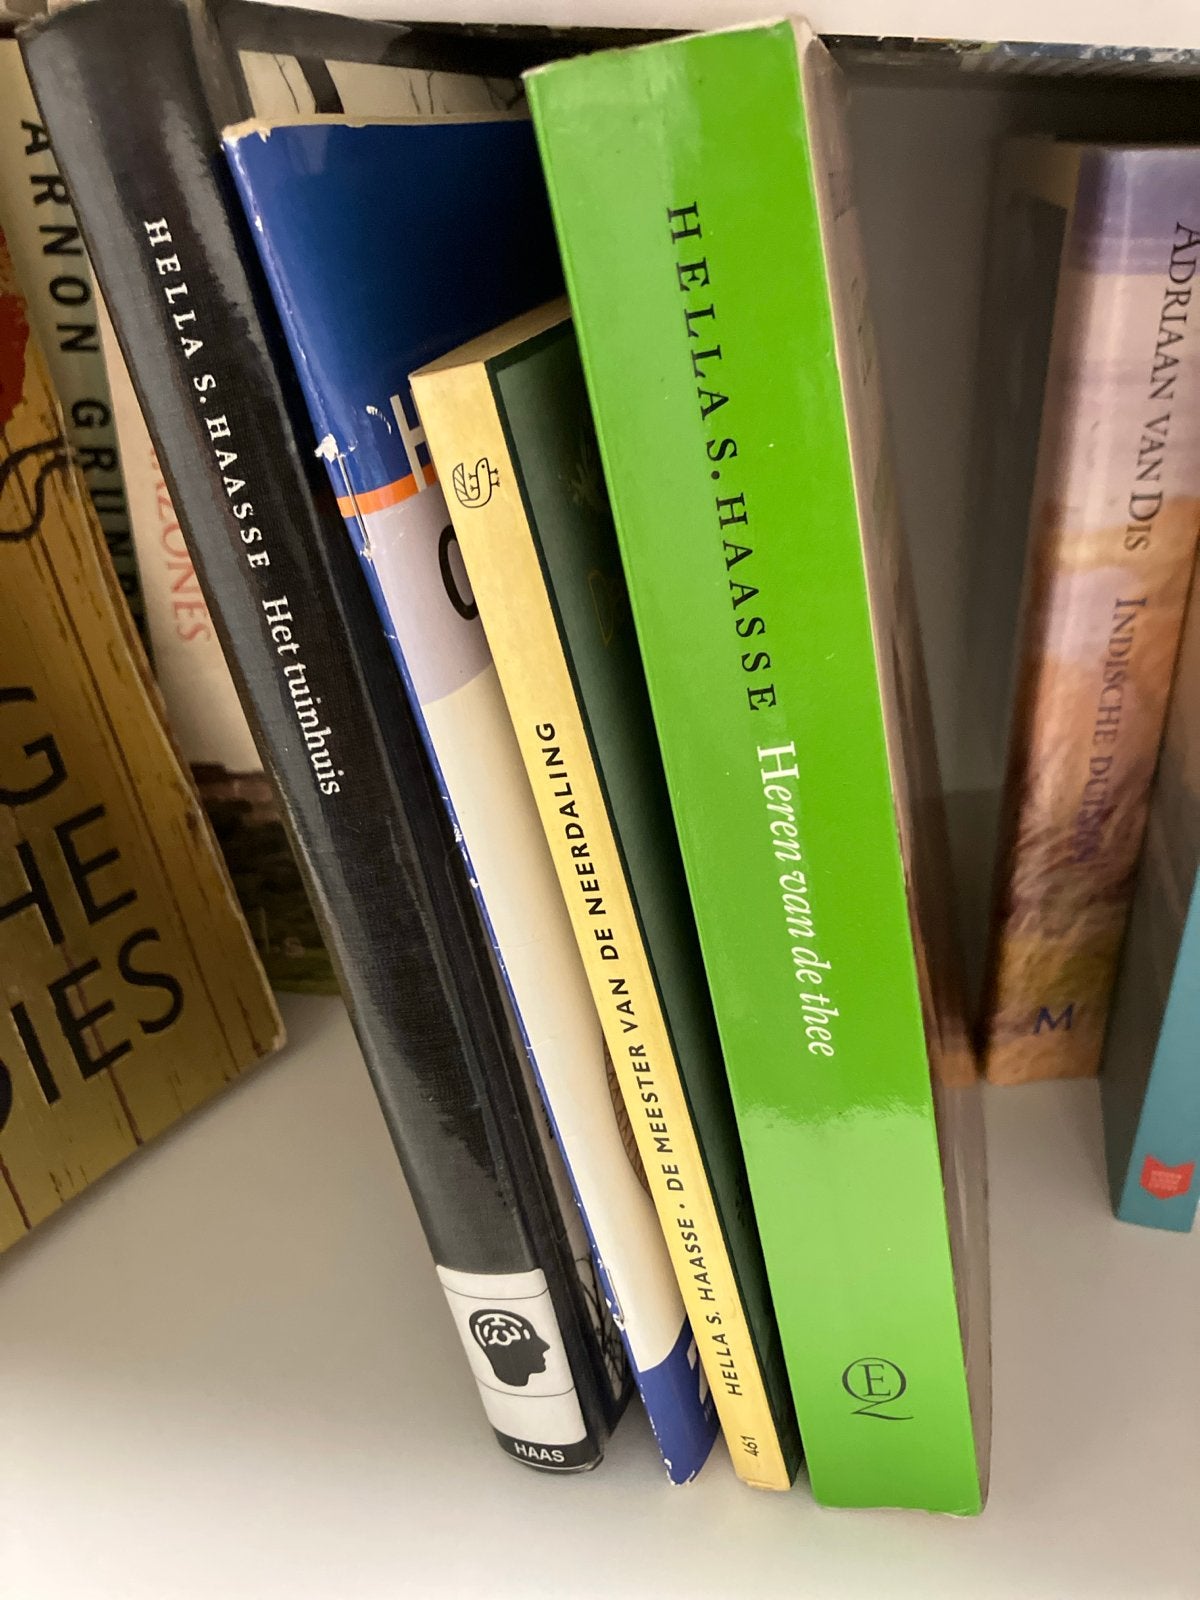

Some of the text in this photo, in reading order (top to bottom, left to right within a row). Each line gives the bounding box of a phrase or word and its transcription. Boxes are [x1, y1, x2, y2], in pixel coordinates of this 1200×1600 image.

[21, 119, 99, 353] ARNON
[1124, 221, 1200, 551] ADRIAAN VAN DIS
[144, 217, 345, 795] HELLA S. HAASSE Het tuinhuis
[667, 201, 839, 1057] HELLA S. HAASSE Heren van de thee
[1092, 597, 1147, 746] INDISCHE
[536, 722, 607, 916] NEERDALING
[594, 928, 620, 961] DE
[608, 977, 639, 1034] VAN
[628, 1043, 674, 1154] MEESTER
[661, 1163, 685, 1192] DE
[677, 1217, 715, 1301] HAASSE
[706, 1311, 722, 1325] S.
[712, 1333, 743, 1396] HELLA
[513, 1441, 566, 1464] HAAS
[741, 1434, 759, 1457] 461
